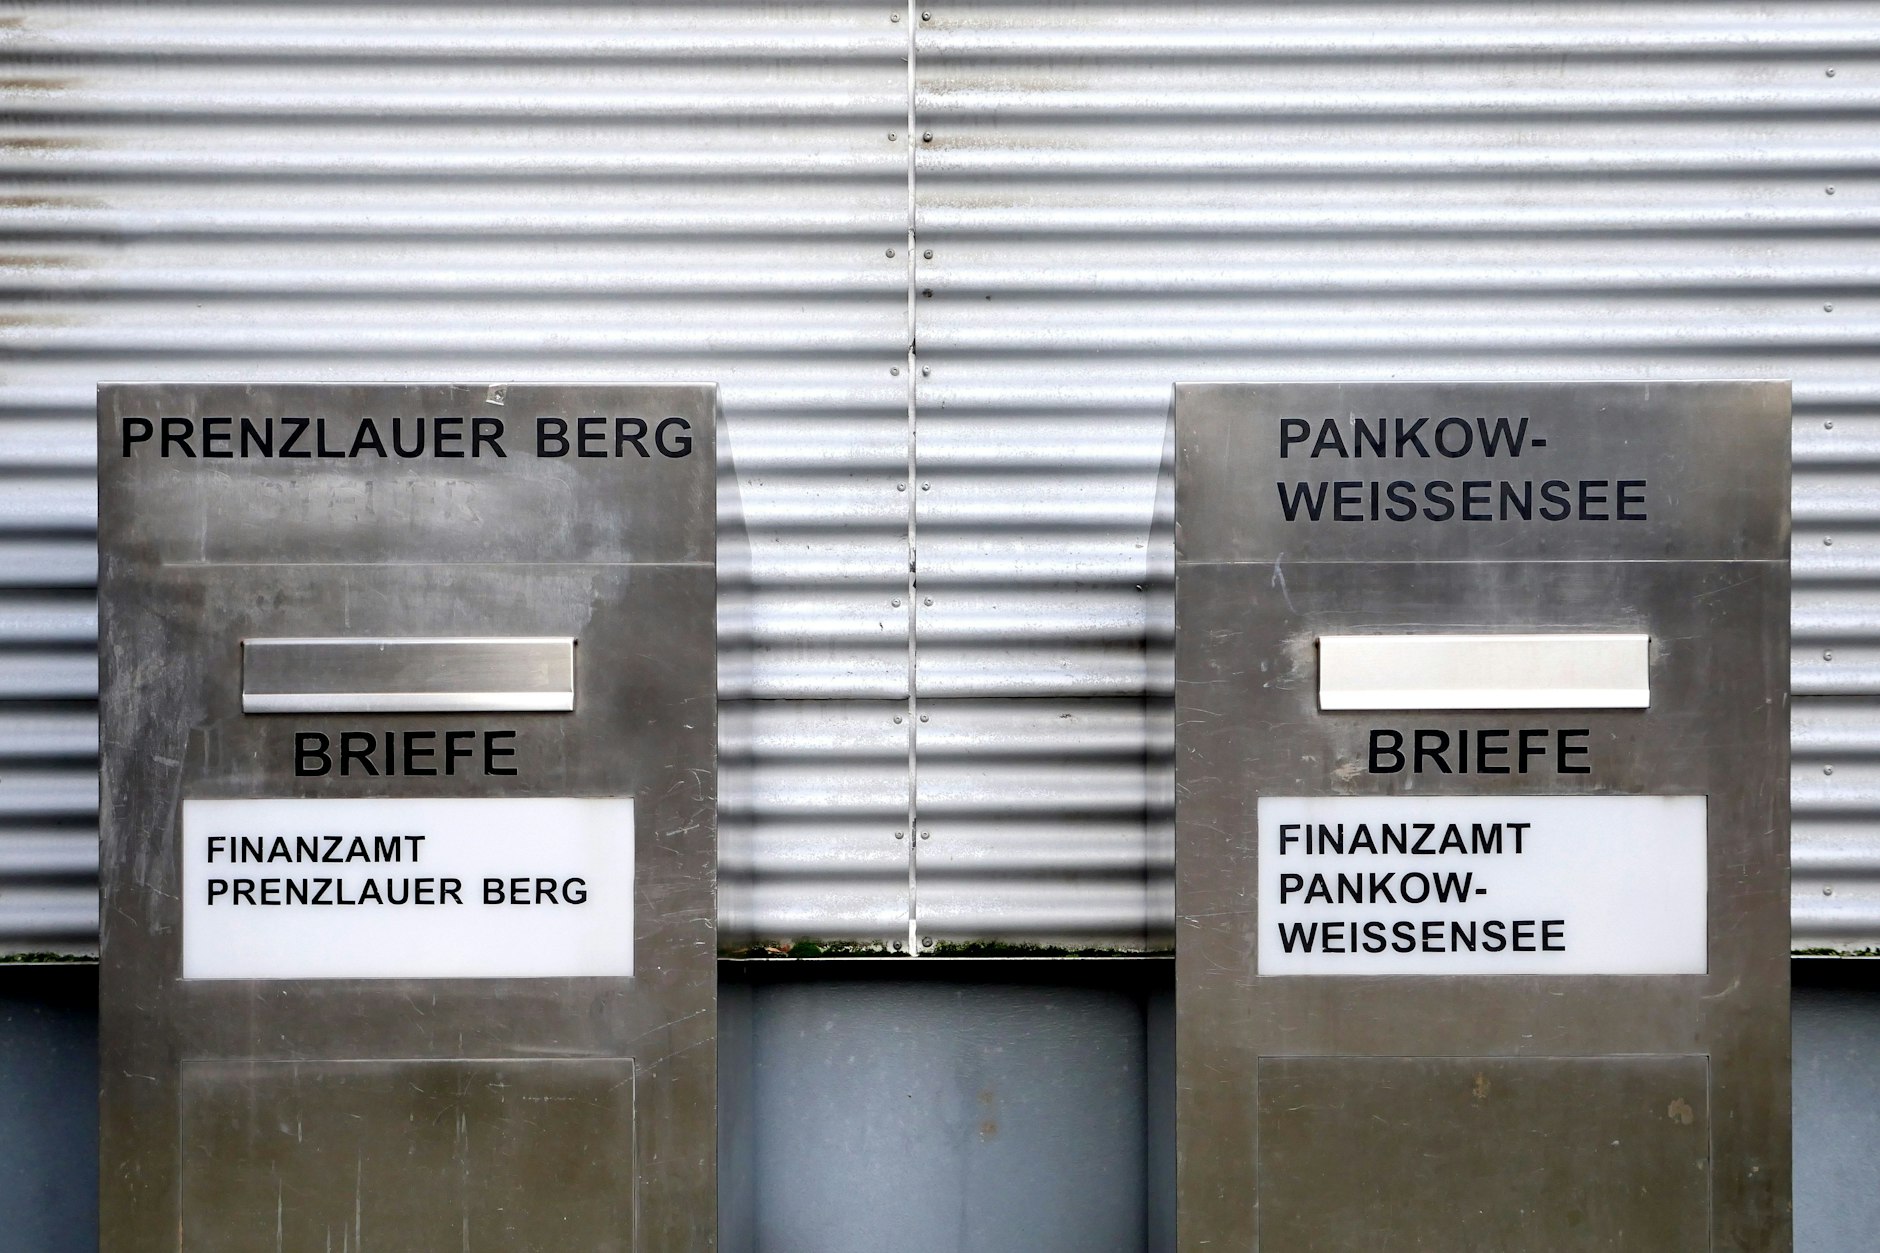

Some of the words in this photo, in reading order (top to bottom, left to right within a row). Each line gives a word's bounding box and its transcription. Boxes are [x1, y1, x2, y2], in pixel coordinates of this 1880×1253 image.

[122, 417, 507, 459] PRENZLAUER
[537, 417, 693, 459] BERG
[1280, 417, 1547, 459] PANKOW-
[1276, 480, 1647, 522] WEISSENSEE
[294, 730, 518, 777] BRIEFE
[1368, 729, 1591, 774] BRIEFE
[206, 835, 426, 863] FINANZAMT
[1279, 822, 1531, 855] FINANZAMT
[206, 877, 464, 906] PRENZLAUER
[483, 877, 588, 905] BERG
[1279, 871, 1487, 905] PANKOW-
[1277, 919, 1566, 954] WEISSENSEE
